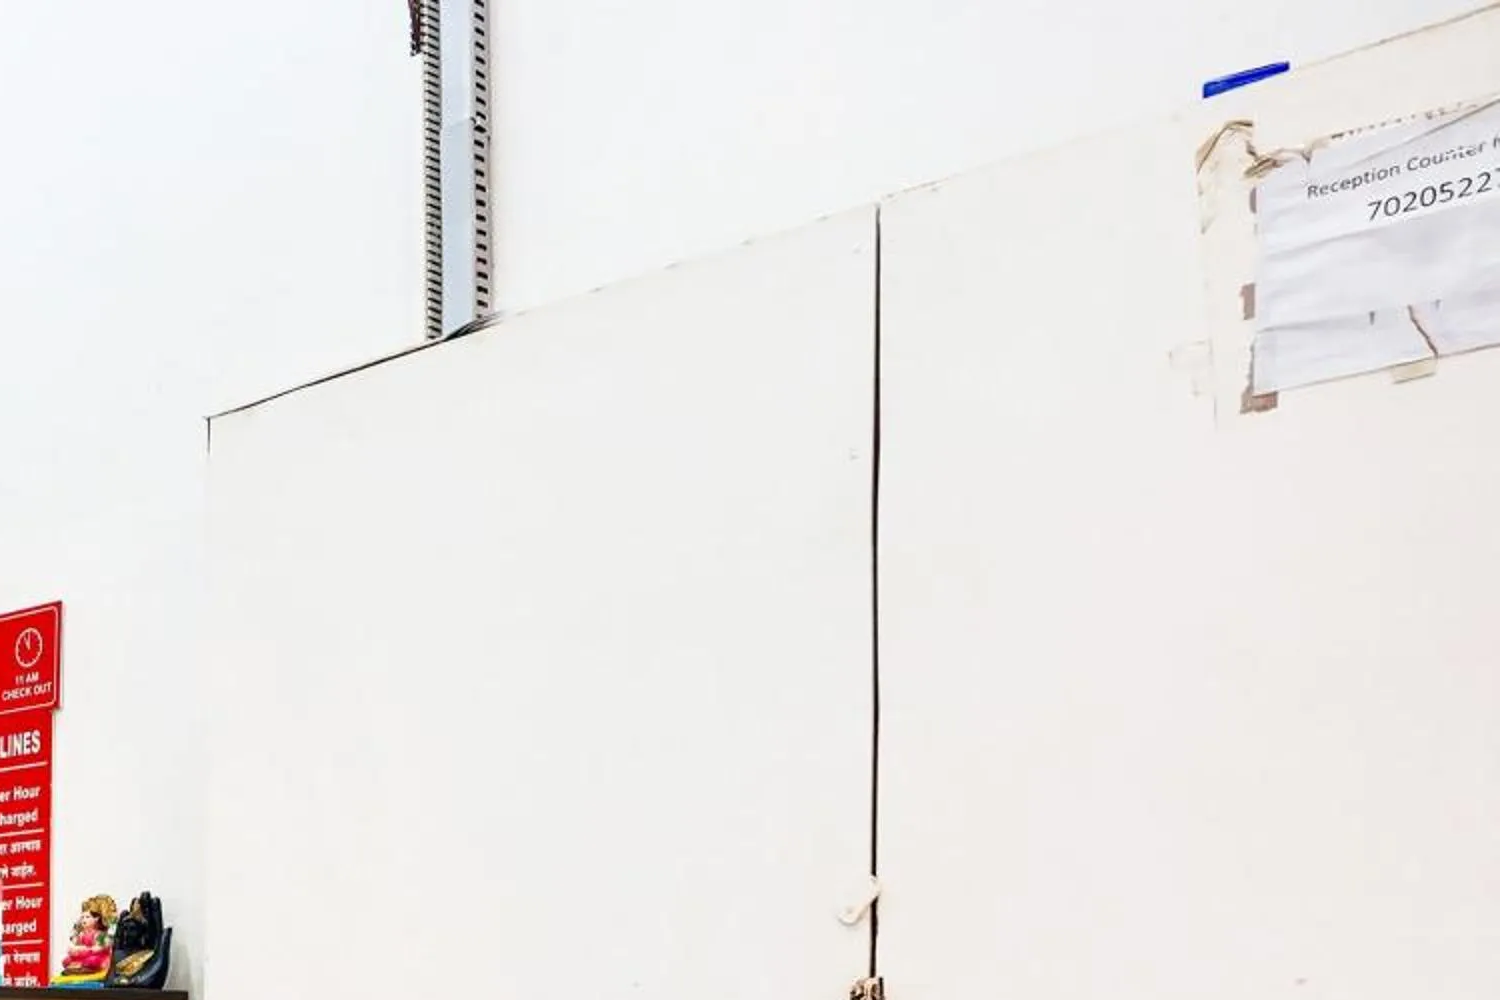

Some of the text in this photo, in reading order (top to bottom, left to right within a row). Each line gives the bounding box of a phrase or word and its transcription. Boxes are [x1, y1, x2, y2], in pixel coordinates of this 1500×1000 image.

[1307, 163, 1400, 199] Reception
[25, 671, 40, 683] AM
[1, 681, 52, 701] CHECK OUT
[13, 786, 41, 801] Hour
[15, 896, 43, 910] Hour
[2, 919, 37, 936] arged
